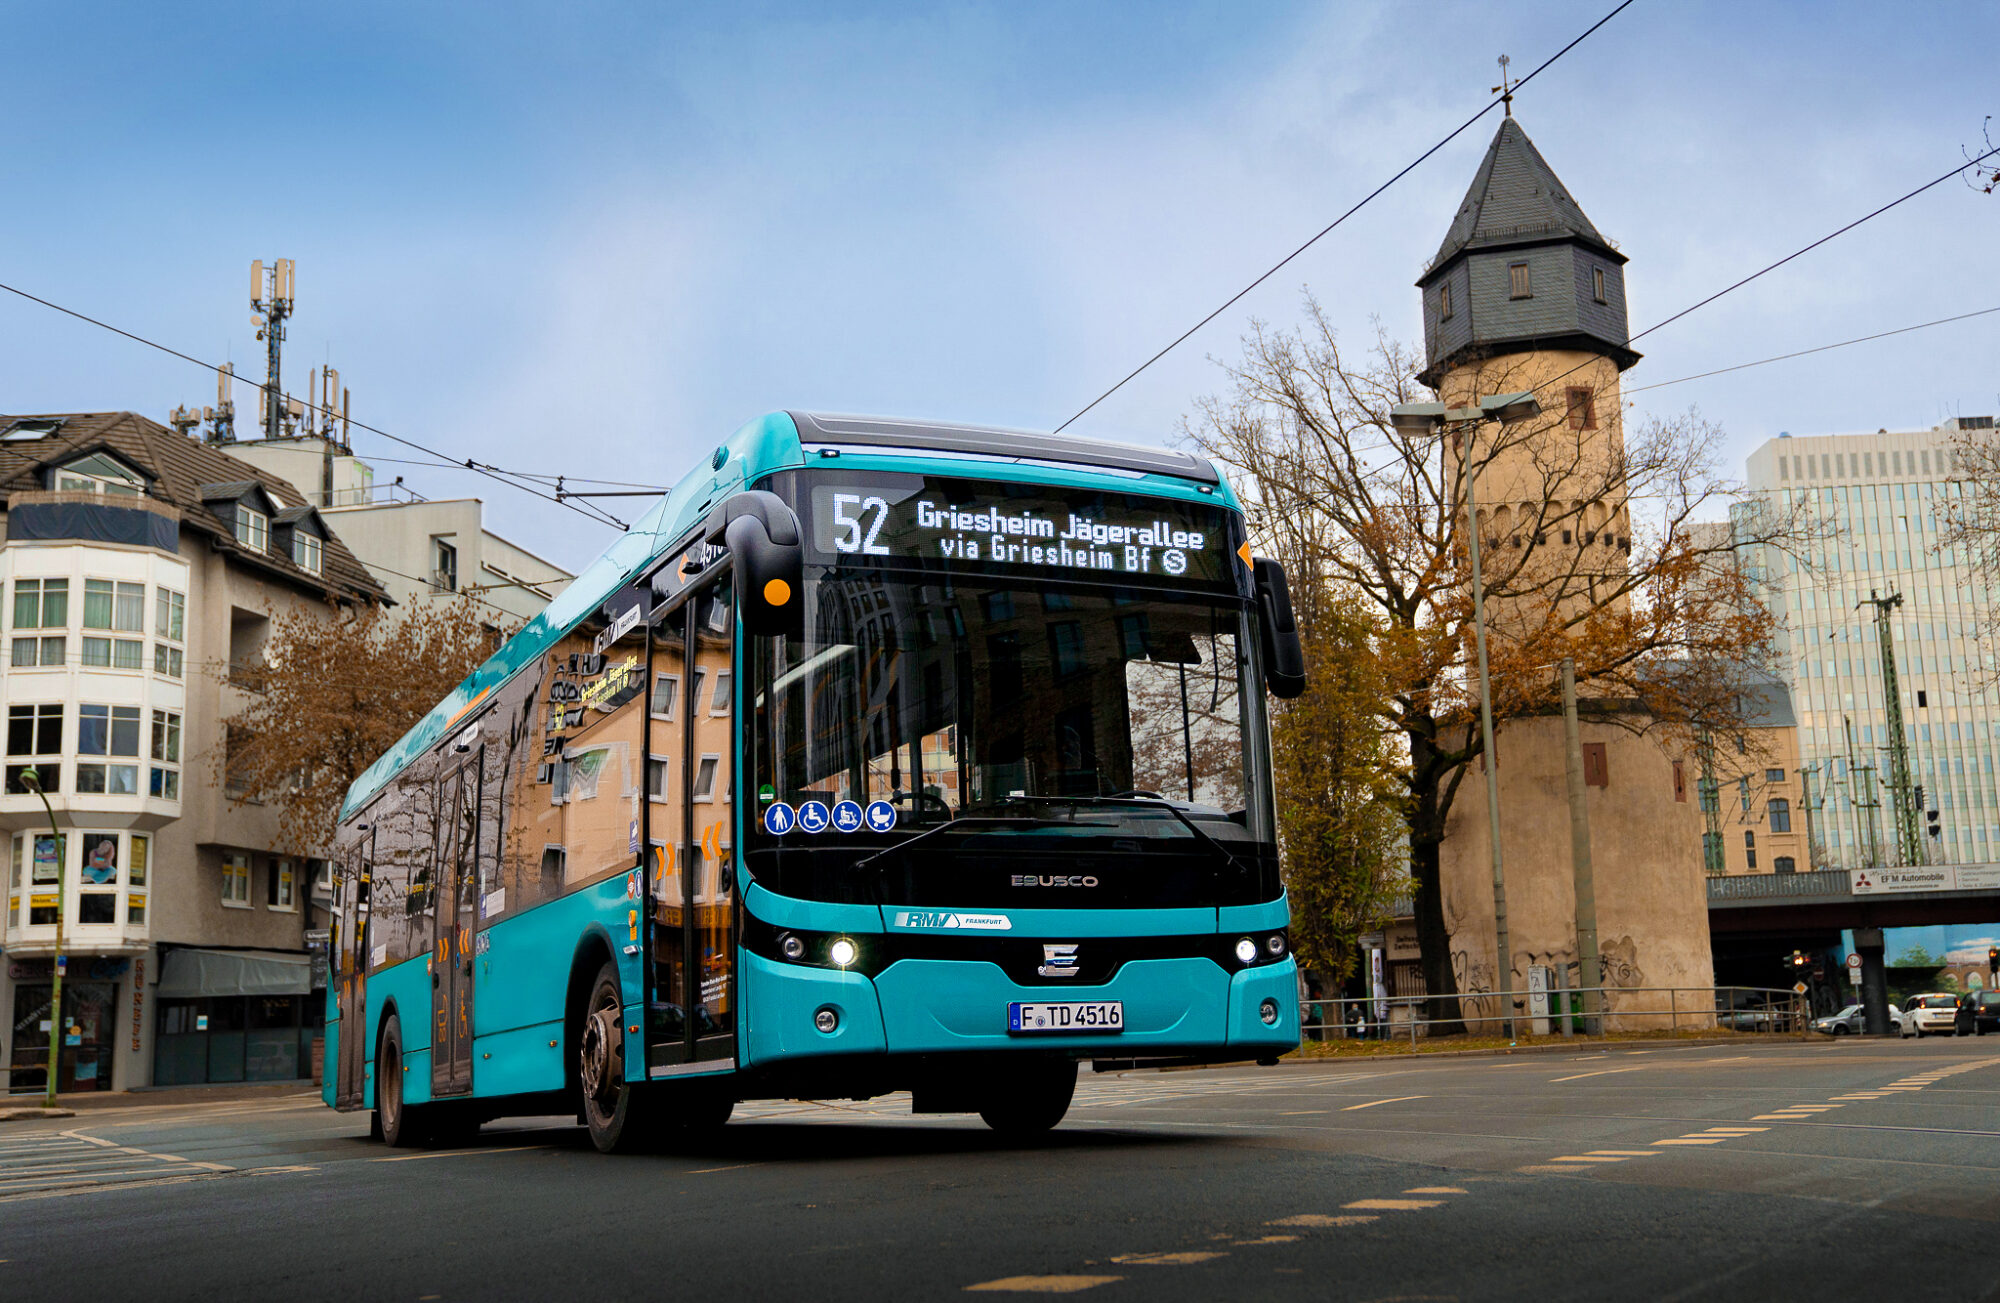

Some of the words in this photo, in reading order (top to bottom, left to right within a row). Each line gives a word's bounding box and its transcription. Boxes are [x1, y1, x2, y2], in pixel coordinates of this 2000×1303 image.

[833, 493, 890, 556] 52
[917, 500, 1054, 538] Griesheim
[1060, 513, 1204, 550] Jägerallee
[940, 533, 979, 559] via
[991, 534, 1113, 570] Griesheim
[1124, 545, 1150, 572] Bf
[1011, 875, 1099, 887] EBUSCO
[1901, 873, 1945, 883] Automobile
[905, 912, 952, 927] RMV
[1022, 1006, 1034, 1026] F
[1046, 1006, 1070, 1026] TD
[1075, 1005, 1119, 1025] 4516
